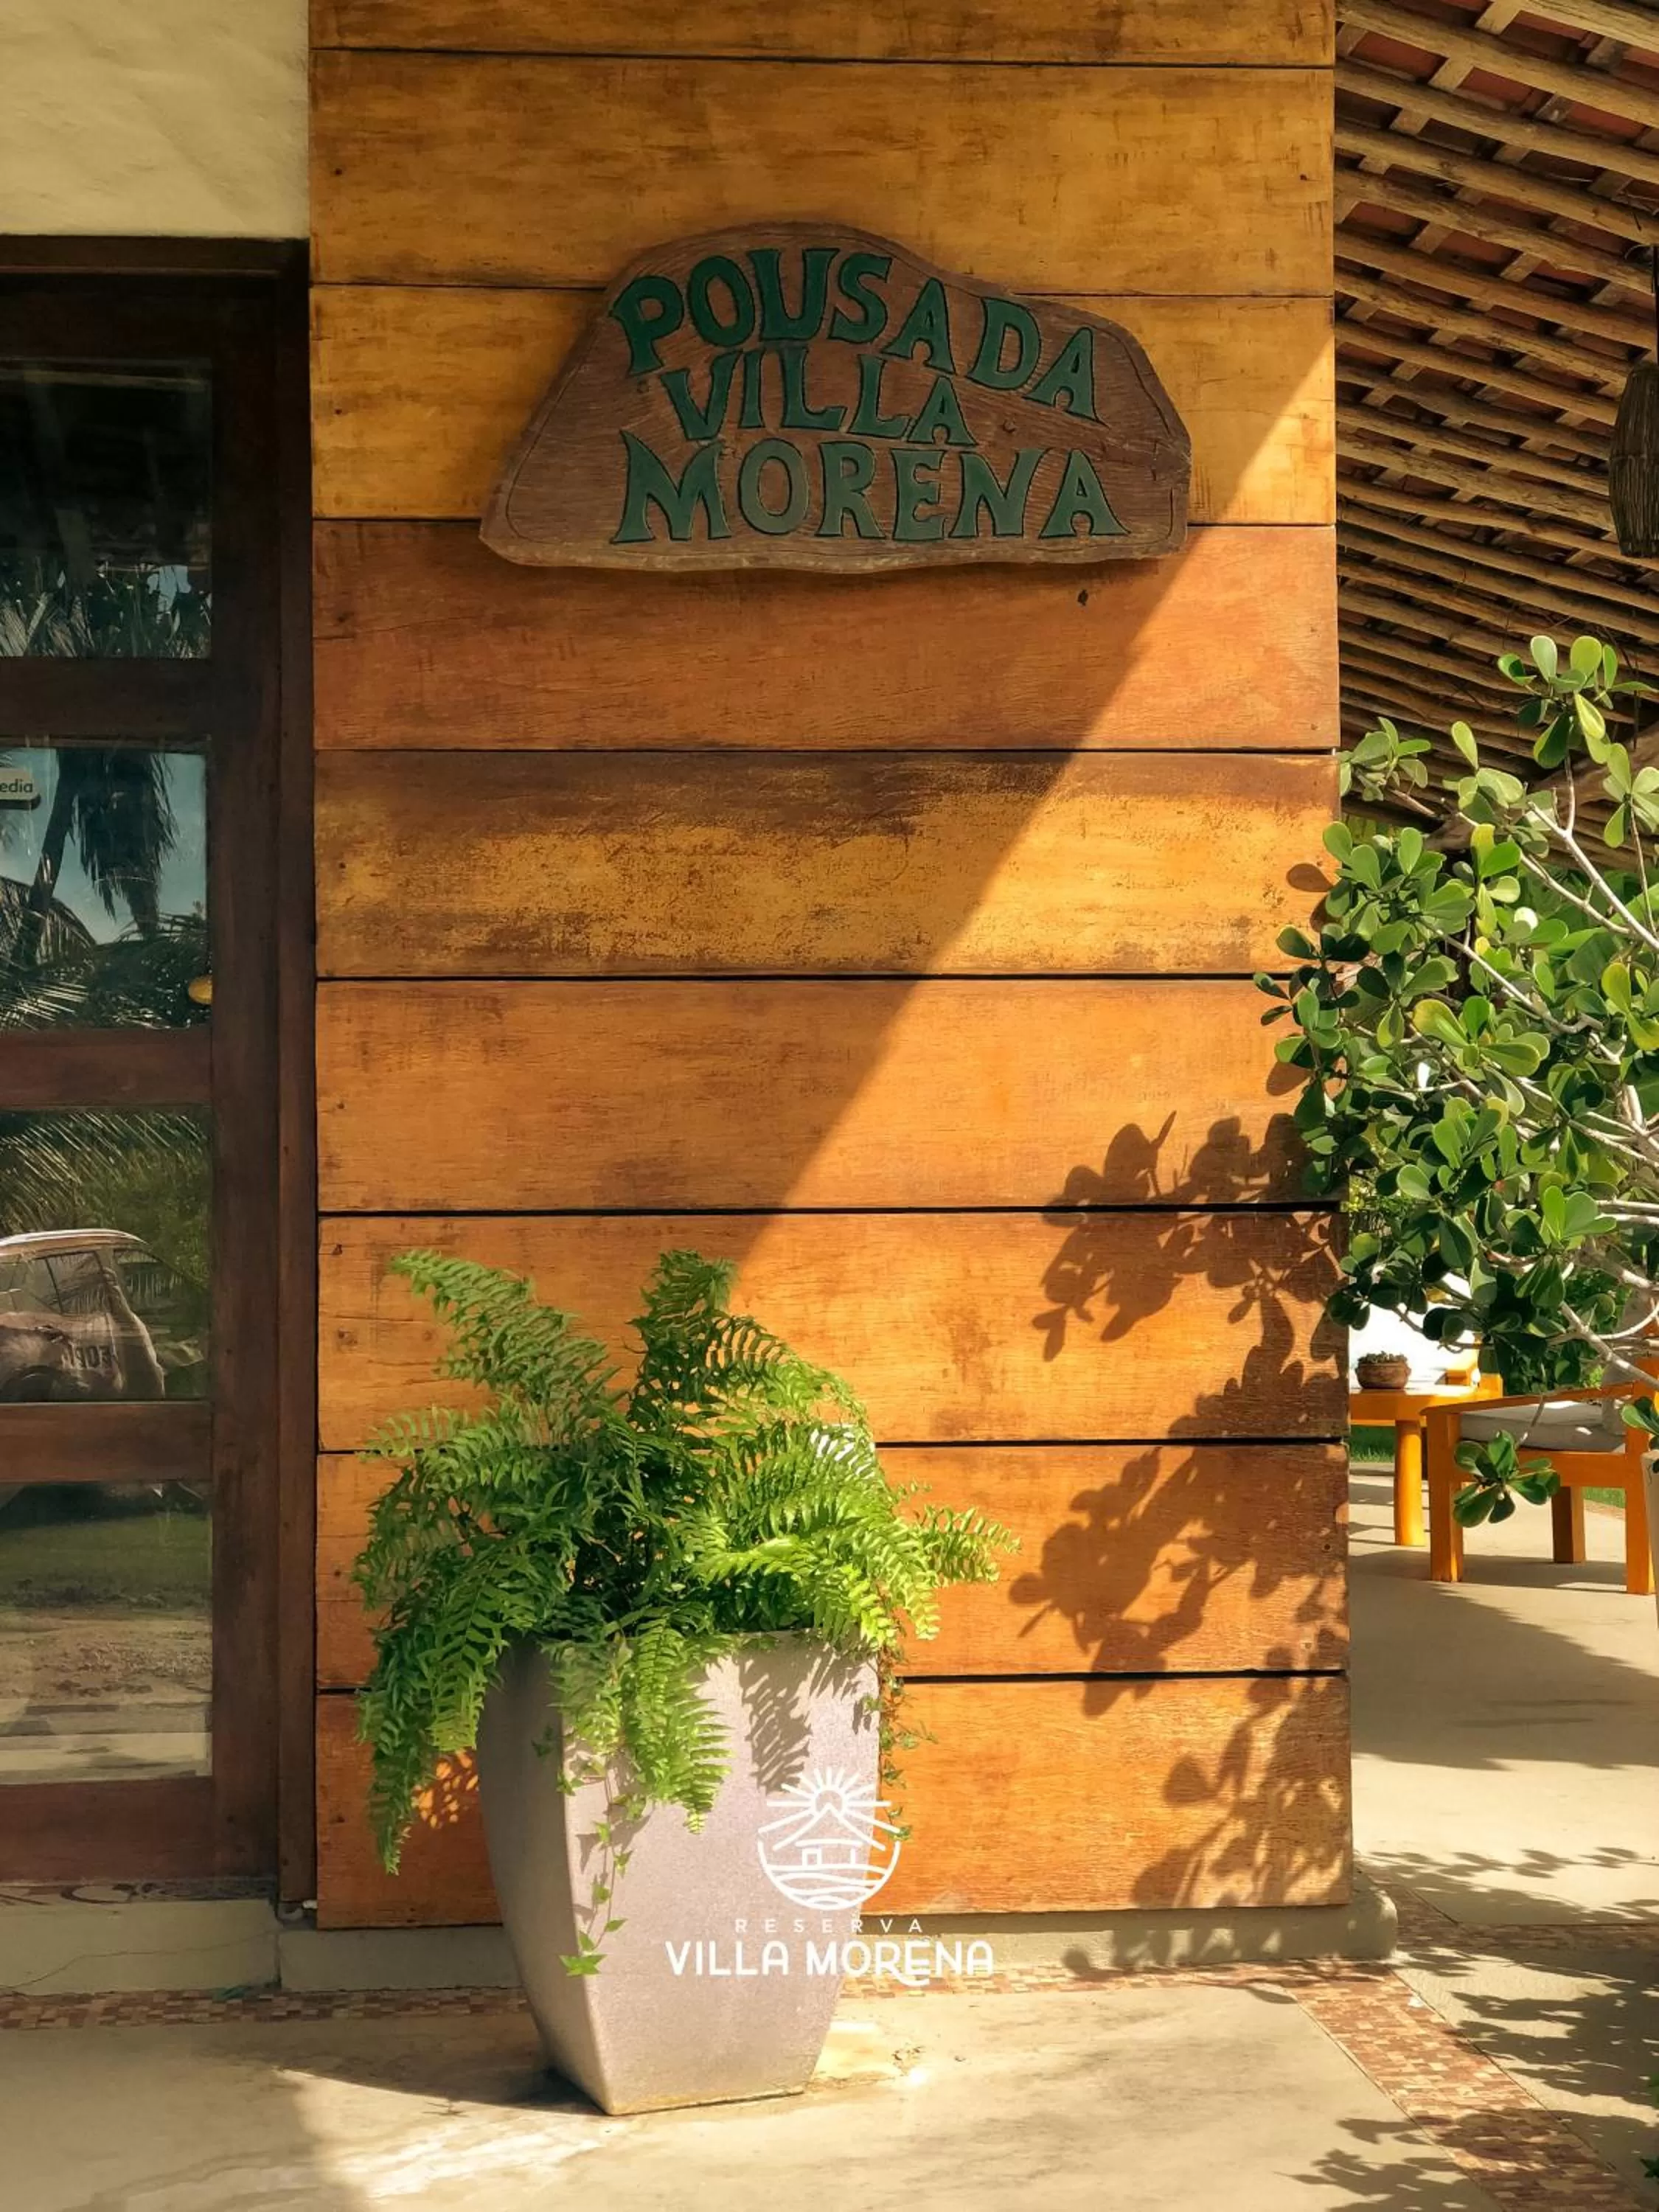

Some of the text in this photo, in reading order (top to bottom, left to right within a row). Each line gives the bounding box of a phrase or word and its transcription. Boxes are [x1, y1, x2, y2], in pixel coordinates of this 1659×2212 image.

[611, 247, 1109, 427] POUSADA
[661, 344, 978, 446] VILLA
[610, 430, 1130, 543] MORENA
[0, 779, 33, 793] edia
